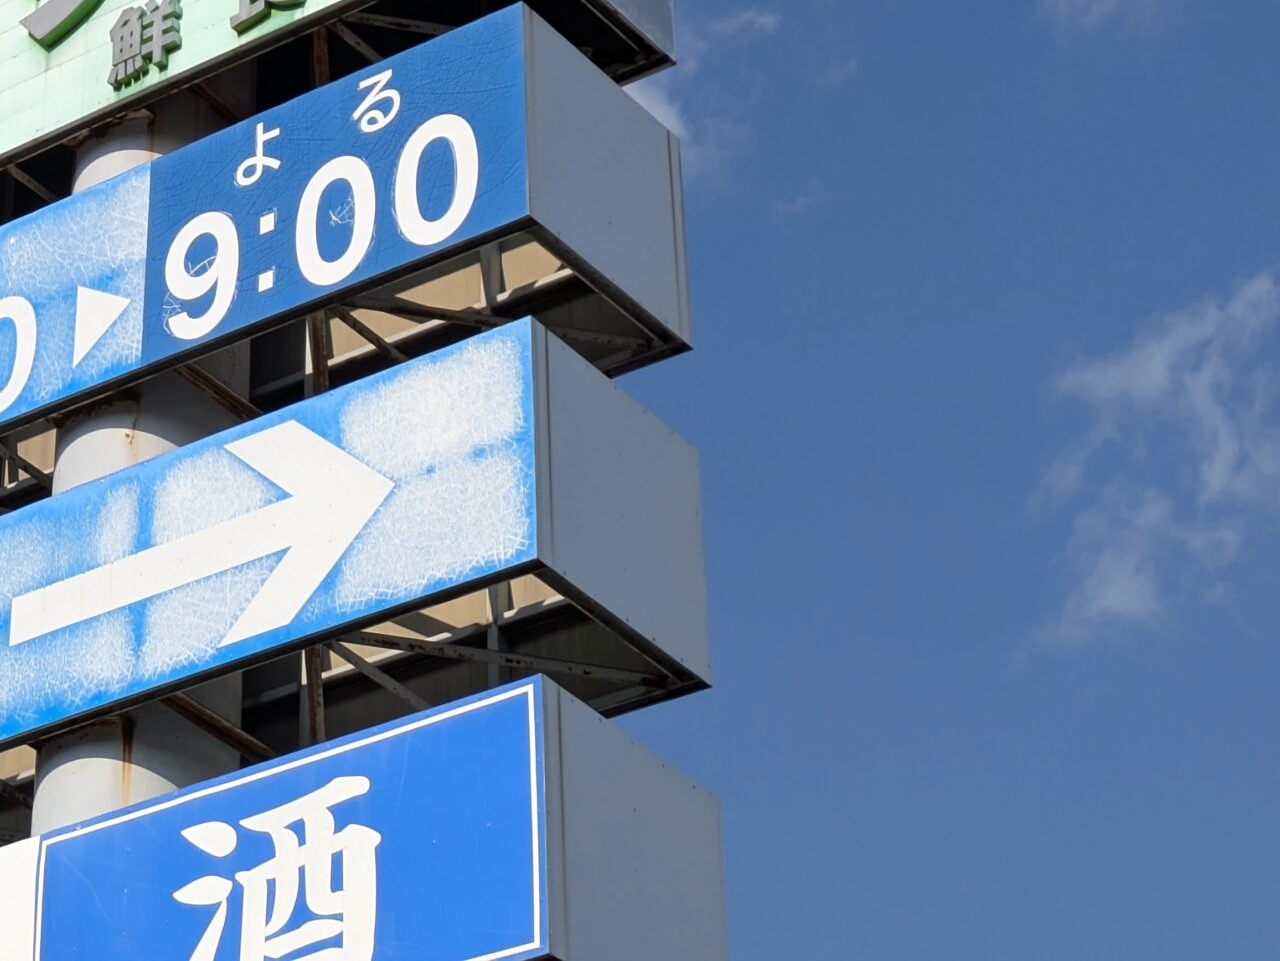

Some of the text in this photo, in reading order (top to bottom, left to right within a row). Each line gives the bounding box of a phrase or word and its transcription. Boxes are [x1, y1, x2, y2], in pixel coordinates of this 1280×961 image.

[235, 69, 401, 187] よる
[163, 114, 478, 341] 9:00
[173, 775, 381, 961] 酒
